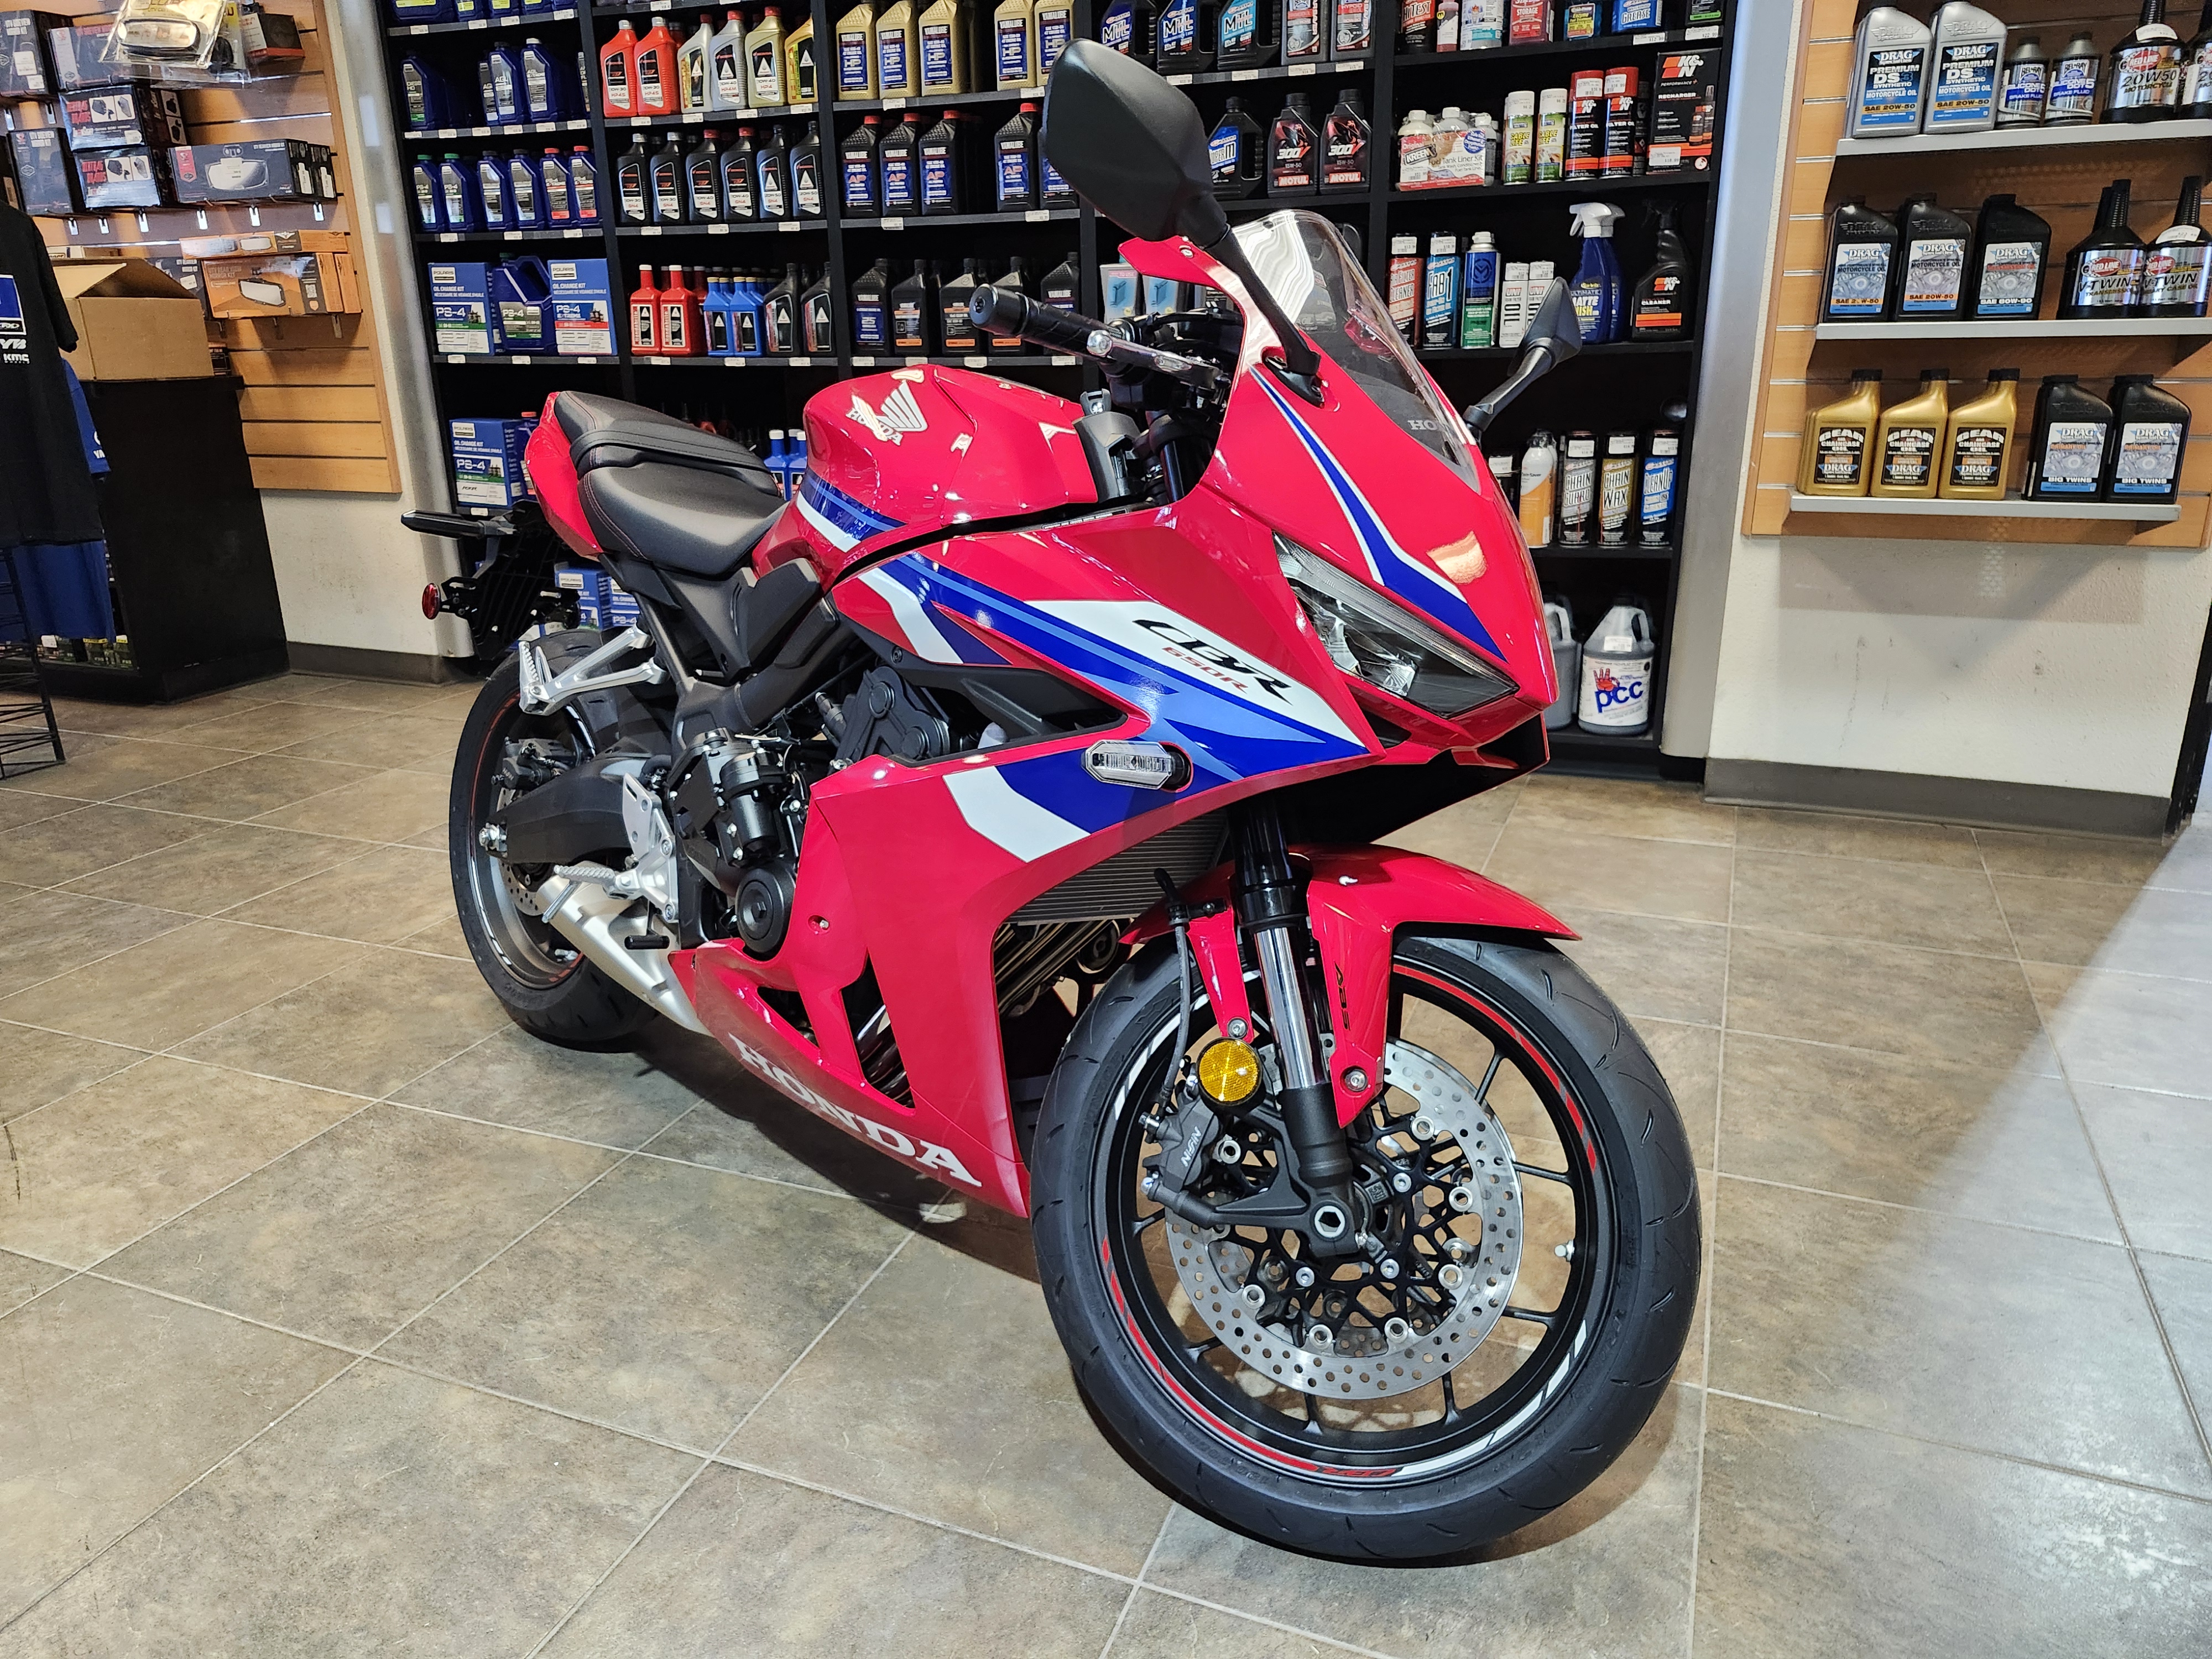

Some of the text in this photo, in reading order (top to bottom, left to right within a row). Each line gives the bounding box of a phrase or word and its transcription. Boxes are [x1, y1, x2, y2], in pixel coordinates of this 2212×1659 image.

[1516, 7, 1538, 16] STORAGE
[1621, 8, 1650, 25] GREASE
[1003, 46, 1021, 56] HP
[1880, 50, 1913, 61] DRAG
[1953, 45, 1986, 56] DRAG
[885, 56, 901, 65] HP
[928, 52, 946, 61] HP
[2130, 55, 2158, 66] RED LINE
[1870, 65, 1920, 74] PREMIUM
[1943, 59, 1994, 70] PREMIUM
[2085, 79, 2095, 88] 5
[2121, 70, 2177, 88] 20W50
[1866, 91, 1906, 99] MOTORCYCLE
[1938, 85, 1980, 95] MOTORCYCLE
[1276, 145, 1312, 160] 300V
[1328, 140, 1366, 156] 300V
[1406, 145, 1436, 164] KREEM
[1004, 165, 1023, 175] AP
[848, 174, 867, 183] AP
[888, 173, 907, 182] AP
[927, 171, 945, 180] AP
[1330, 173, 1360, 183] MOTUL
[1279, 176, 1308, 186] MOTUL
[1922, 243, 1954, 253] DRAG
[1995, 247, 2028, 258] DRAG
[1848, 249, 1880, 258] DRAG
[2091, 261, 2120, 270] RED LINE
[2158, 260, 2172, 269] LINE
[2078, 276, 2132, 292] V-TWIN
[2145, 273, 2198, 289] V-TWIN
[1505, 288, 1521, 296] UNI
[1529, 286, 1545, 295] UNI
[436, 307, 466, 317] PS-4
[502, 309, 524, 317] PS-4
[556, 305, 581, 314] PS-4
[1504, 304, 1520, 326] OIL
[1819, 429, 1864, 443] GEAR
[1887, 429, 1933, 444] GEAR
[1957, 429, 2004, 444] GEAR
[2062, 428, 2094, 437] DRAG
[2136, 428, 2169, 437] DRAG
[456, 459, 486, 470] PS-4
[1825, 463, 1852, 472] DRAG
[1892, 465, 1920, 473] DRAG
[1961, 465, 1990, 473] DRAG
[1565, 471, 1592, 491] CHAIN
[1604, 470, 1630, 489] CHAIN
[1564, 488, 1591, 507] GUARD
[1604, 487, 1629, 508] WAX
[1133, 619, 1293, 706] CBR
[1162, 646, 1249, 694] 650R
[1594, 680, 1644, 714] pcc
[1333, 961, 1351, 1031] ABS
[728, 1032, 983, 1187] HONDA
[1181, 1125, 1202, 1167] NISSIN
